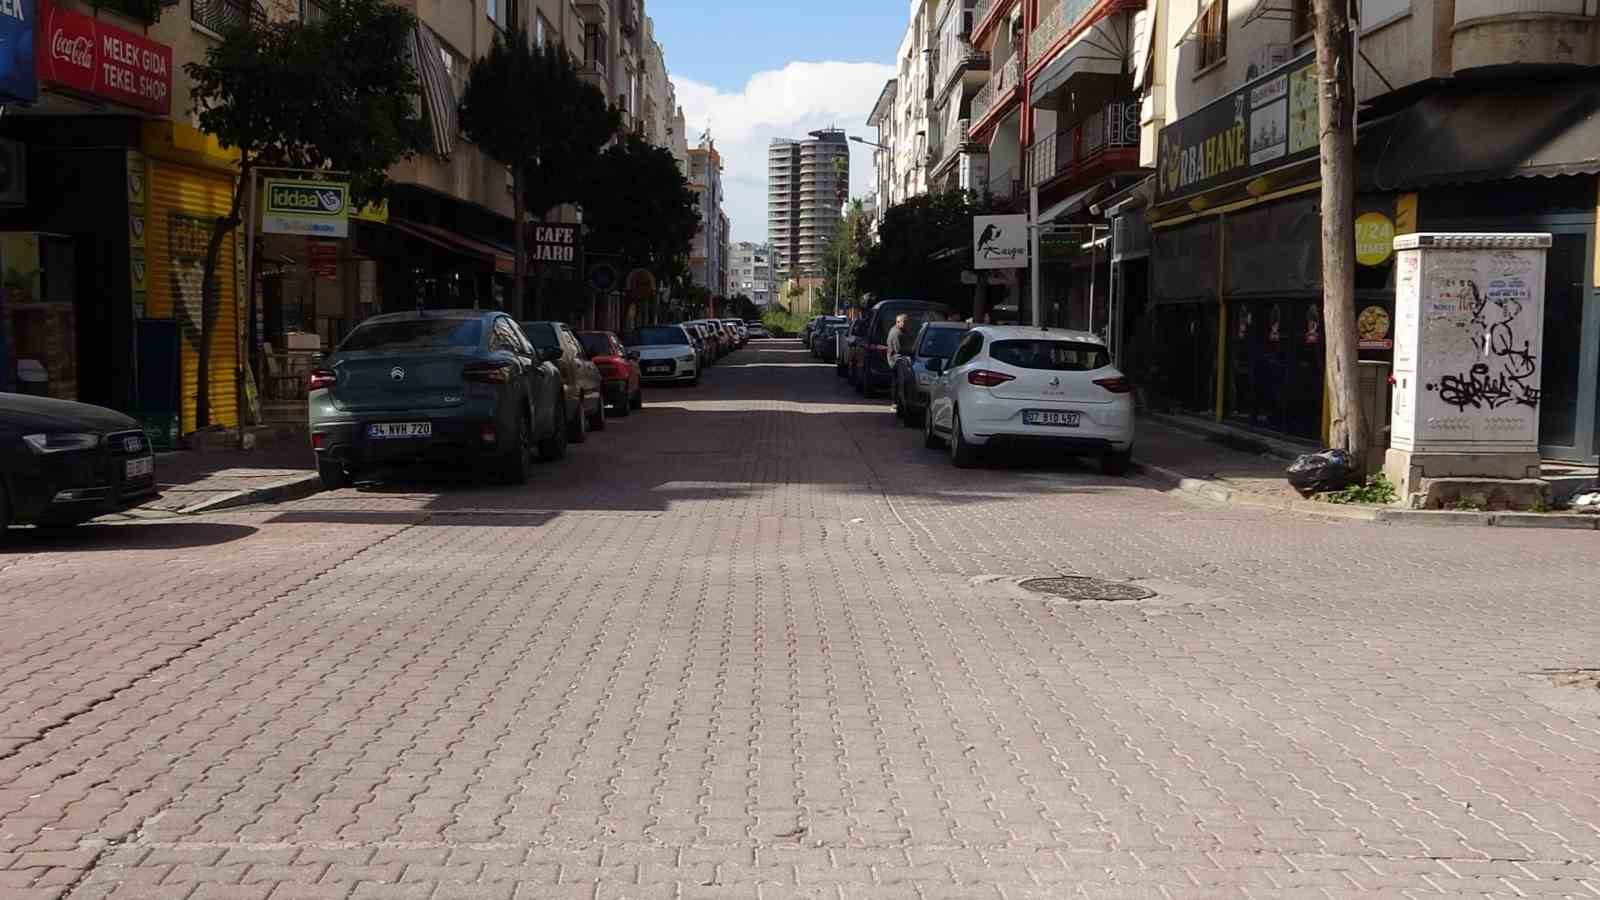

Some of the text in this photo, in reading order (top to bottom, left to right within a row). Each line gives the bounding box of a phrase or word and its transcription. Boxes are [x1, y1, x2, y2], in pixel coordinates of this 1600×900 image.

[103, 35, 168, 77] MELEK GIDA
[103, 63, 168, 102] TEKEL SHOP
[273, 188, 319, 209] iddaa
[535, 226, 575, 244] CAFE
[533, 245, 574, 262] JARO
[1062, 413, 1078, 425] 497
[389, 423, 407, 435] NVH
[411, 423, 431, 434] 720
